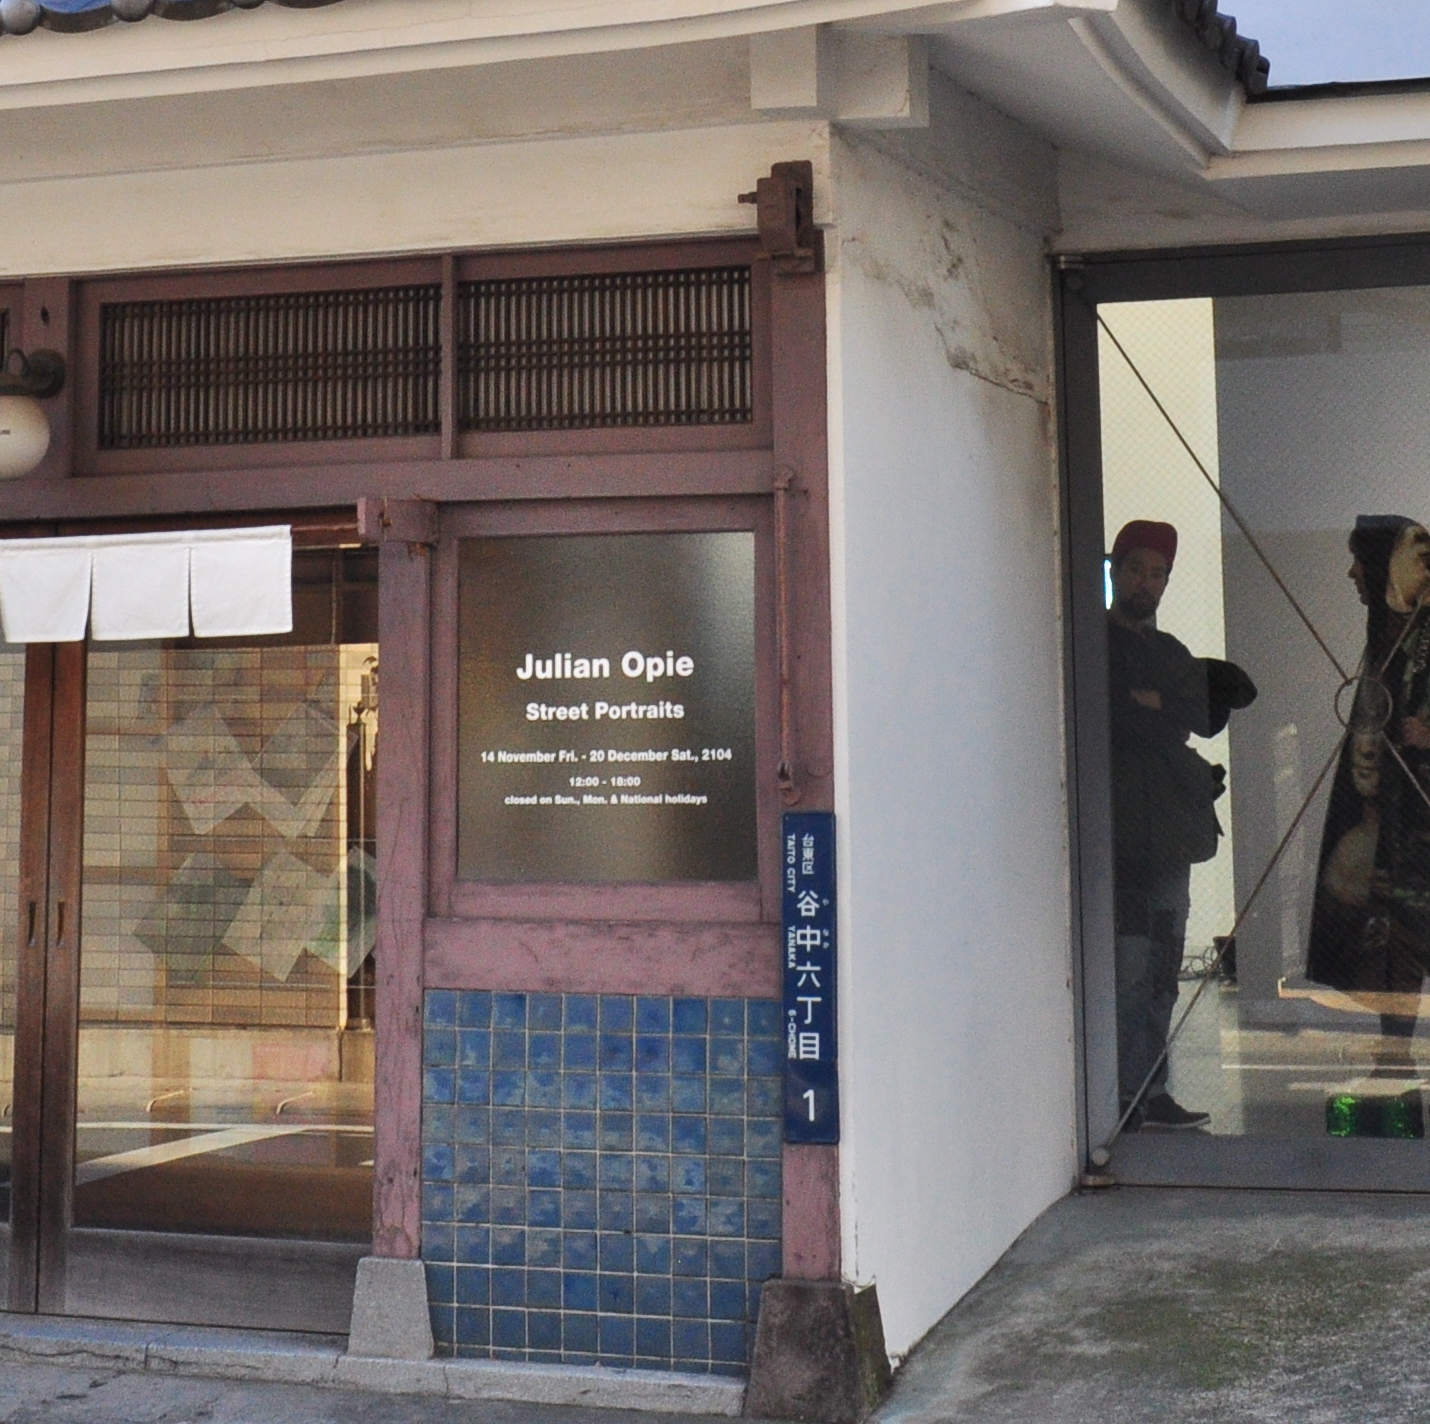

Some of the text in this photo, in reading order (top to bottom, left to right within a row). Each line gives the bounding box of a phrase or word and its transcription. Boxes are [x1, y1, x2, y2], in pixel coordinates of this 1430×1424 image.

[516, 650, 695, 683] Julian Opie
[525, 701, 685, 721] Street Portraits
[480, 751, 495, 763] 14
[497, 750, 556, 763] November
[558, 749, 579, 763] Fri.
[589, 749, 605, 763] 20
[607, 749, 669, 763] December
[701, 748, 732, 761] 2104
[569, 776, 599, 787] 12:00
[504, 794, 537, 805] closed
[539, 796, 553, 805] on
[582, 794, 607, 805] Mon.
[620, 793, 663, 805] National
[664, 793, 708, 807] holidays
[787, 833, 796, 893] TAITO CITY
[787, 925, 797, 969] YANAKA
[796, 889, 822, 1060] 谷中六丁目
[802, 1088, 816, 1123] 1
